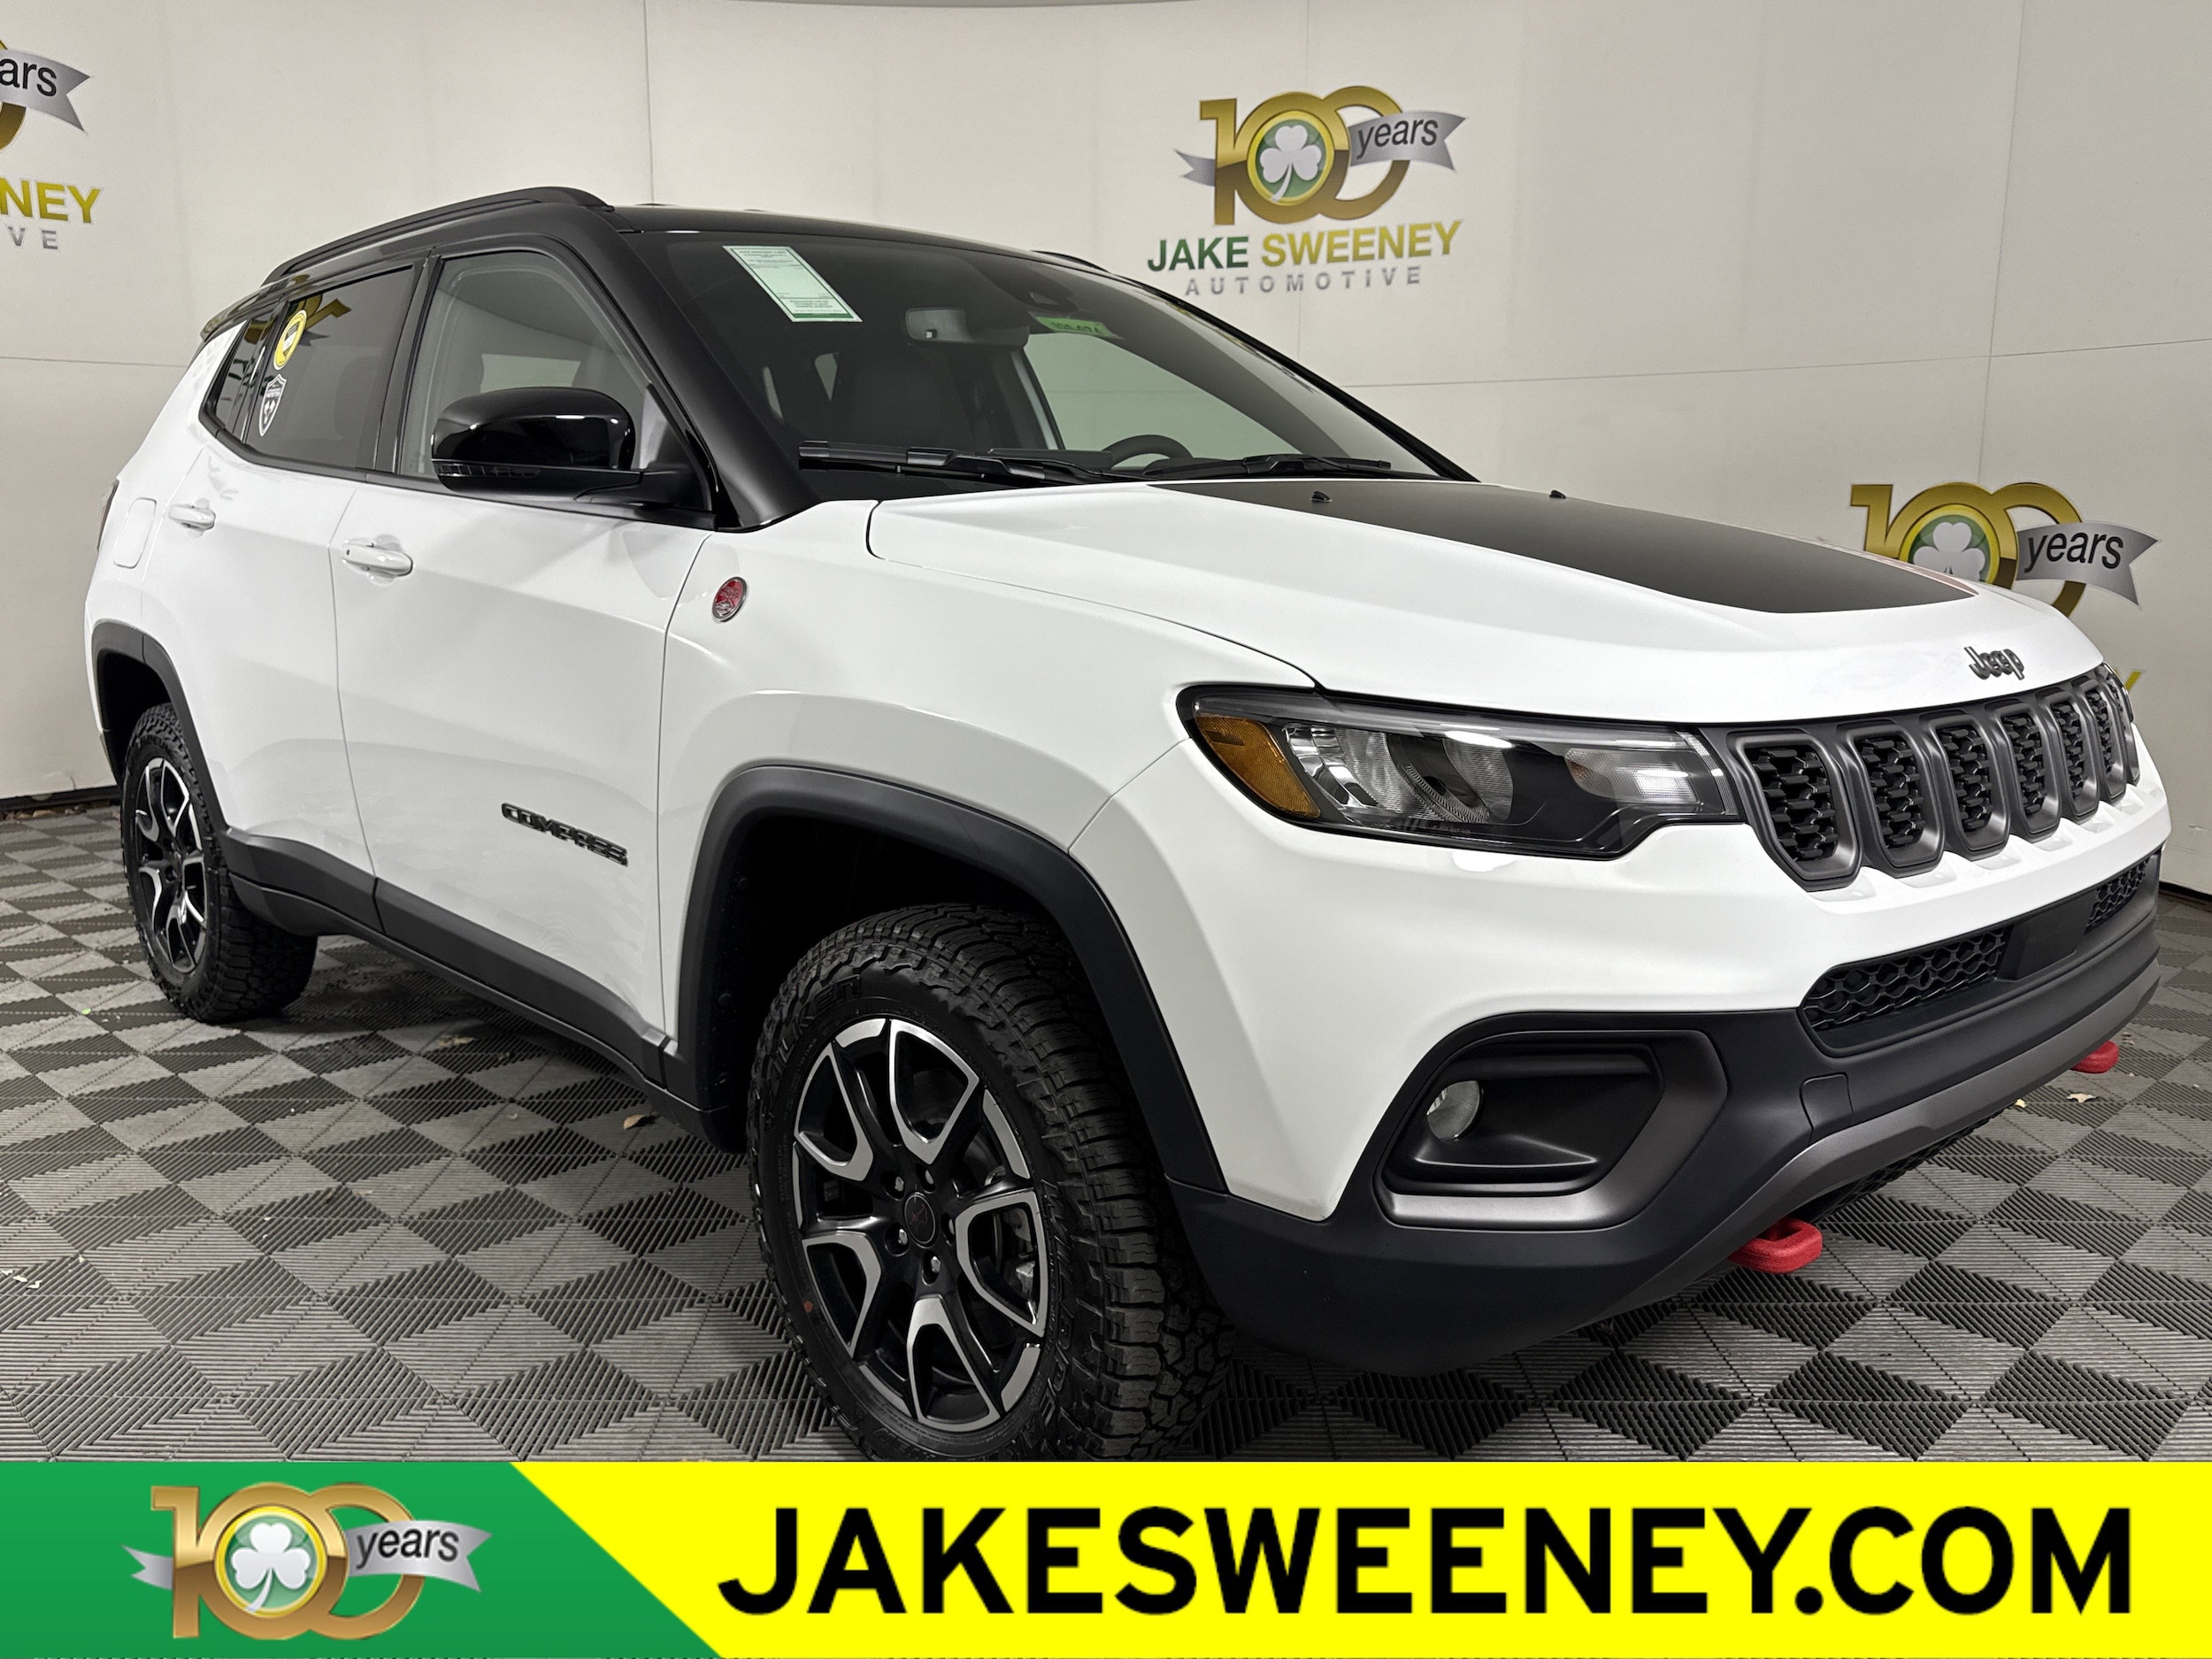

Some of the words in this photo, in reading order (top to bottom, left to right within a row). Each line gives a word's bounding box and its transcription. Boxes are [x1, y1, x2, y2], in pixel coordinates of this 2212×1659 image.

[1356, 116, 1439, 159] years
[1147, 236, 1249, 273] JAKE
[1261, 219, 1463, 267] SWEENEY
[1185, 265, 1421, 296] AUTOMOTIVE
[2024, 532, 2124, 574] years
[1963, 645, 2025, 680] Jeep
[501, 802, 629, 867] COMPASS
